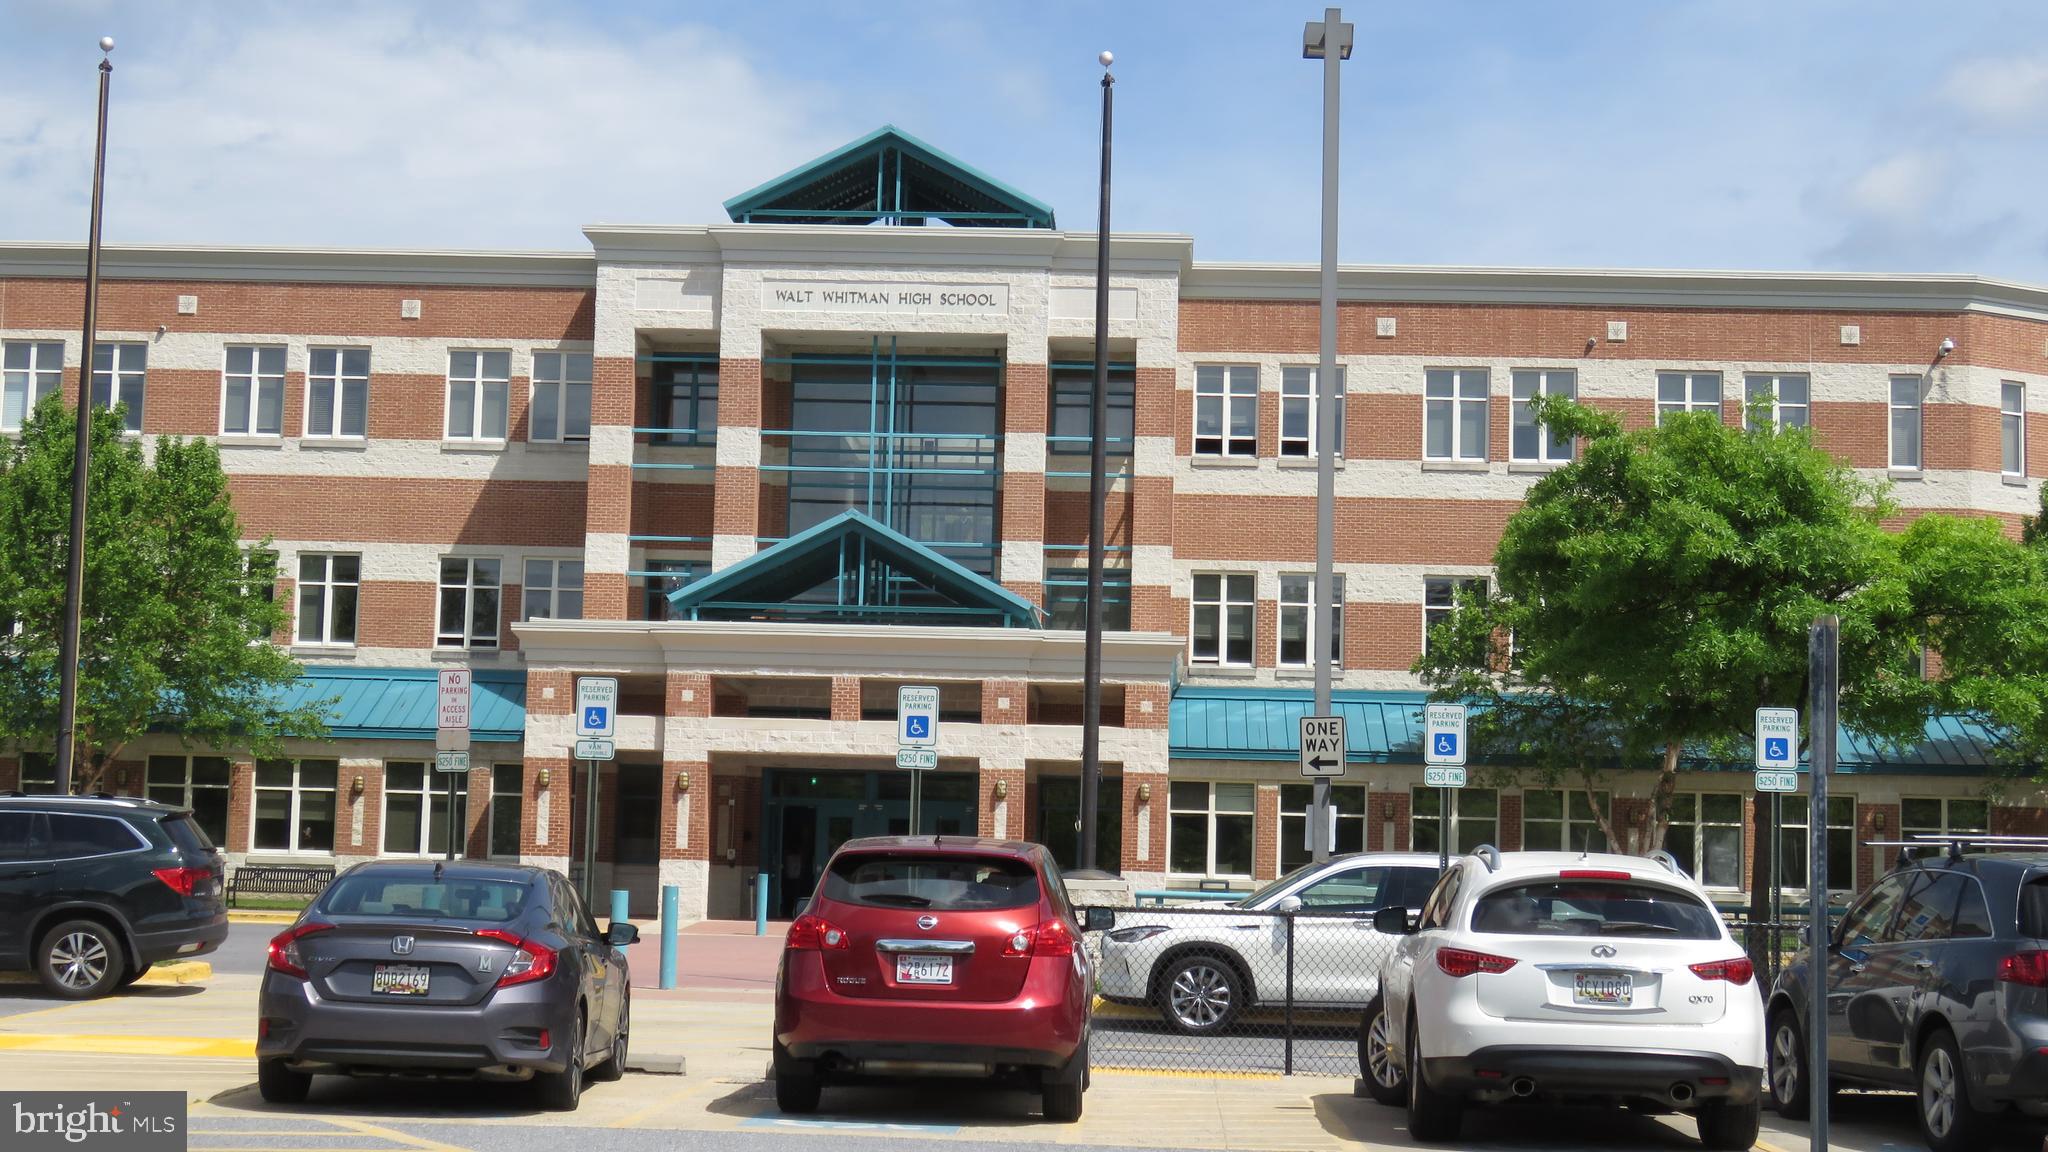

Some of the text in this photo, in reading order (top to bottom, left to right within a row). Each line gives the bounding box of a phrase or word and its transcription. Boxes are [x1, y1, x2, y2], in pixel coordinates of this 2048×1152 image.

[776, 290, 997, 306] WALT WHITMAN HIGH SCHOOL
[448, 676, 461, 684] NO
[441, 687, 468, 695] PARKING
[581, 685, 613, 693] RESERVED
[902, 694, 935, 702] RESERVED
[904, 702, 932, 710] PARKING
[1429, 711, 1463, 720] RESERVED
[1760, 716, 1793, 724] RESERVED
[1432, 720, 1460, 728] PARKING
[1762, 724, 1791, 732] PARKING
[1306, 722, 1339, 736] ONE
[1305, 738, 1339, 752] WAY
[438, 757, 467, 767] $250 FINE
[900, 754, 934, 764] $250 FINE
[1428, 772, 1463, 782] $250 FINE
[1759, 776, 1794, 787] $250 FINE
[1688, 995, 1714, 1004] QX70
